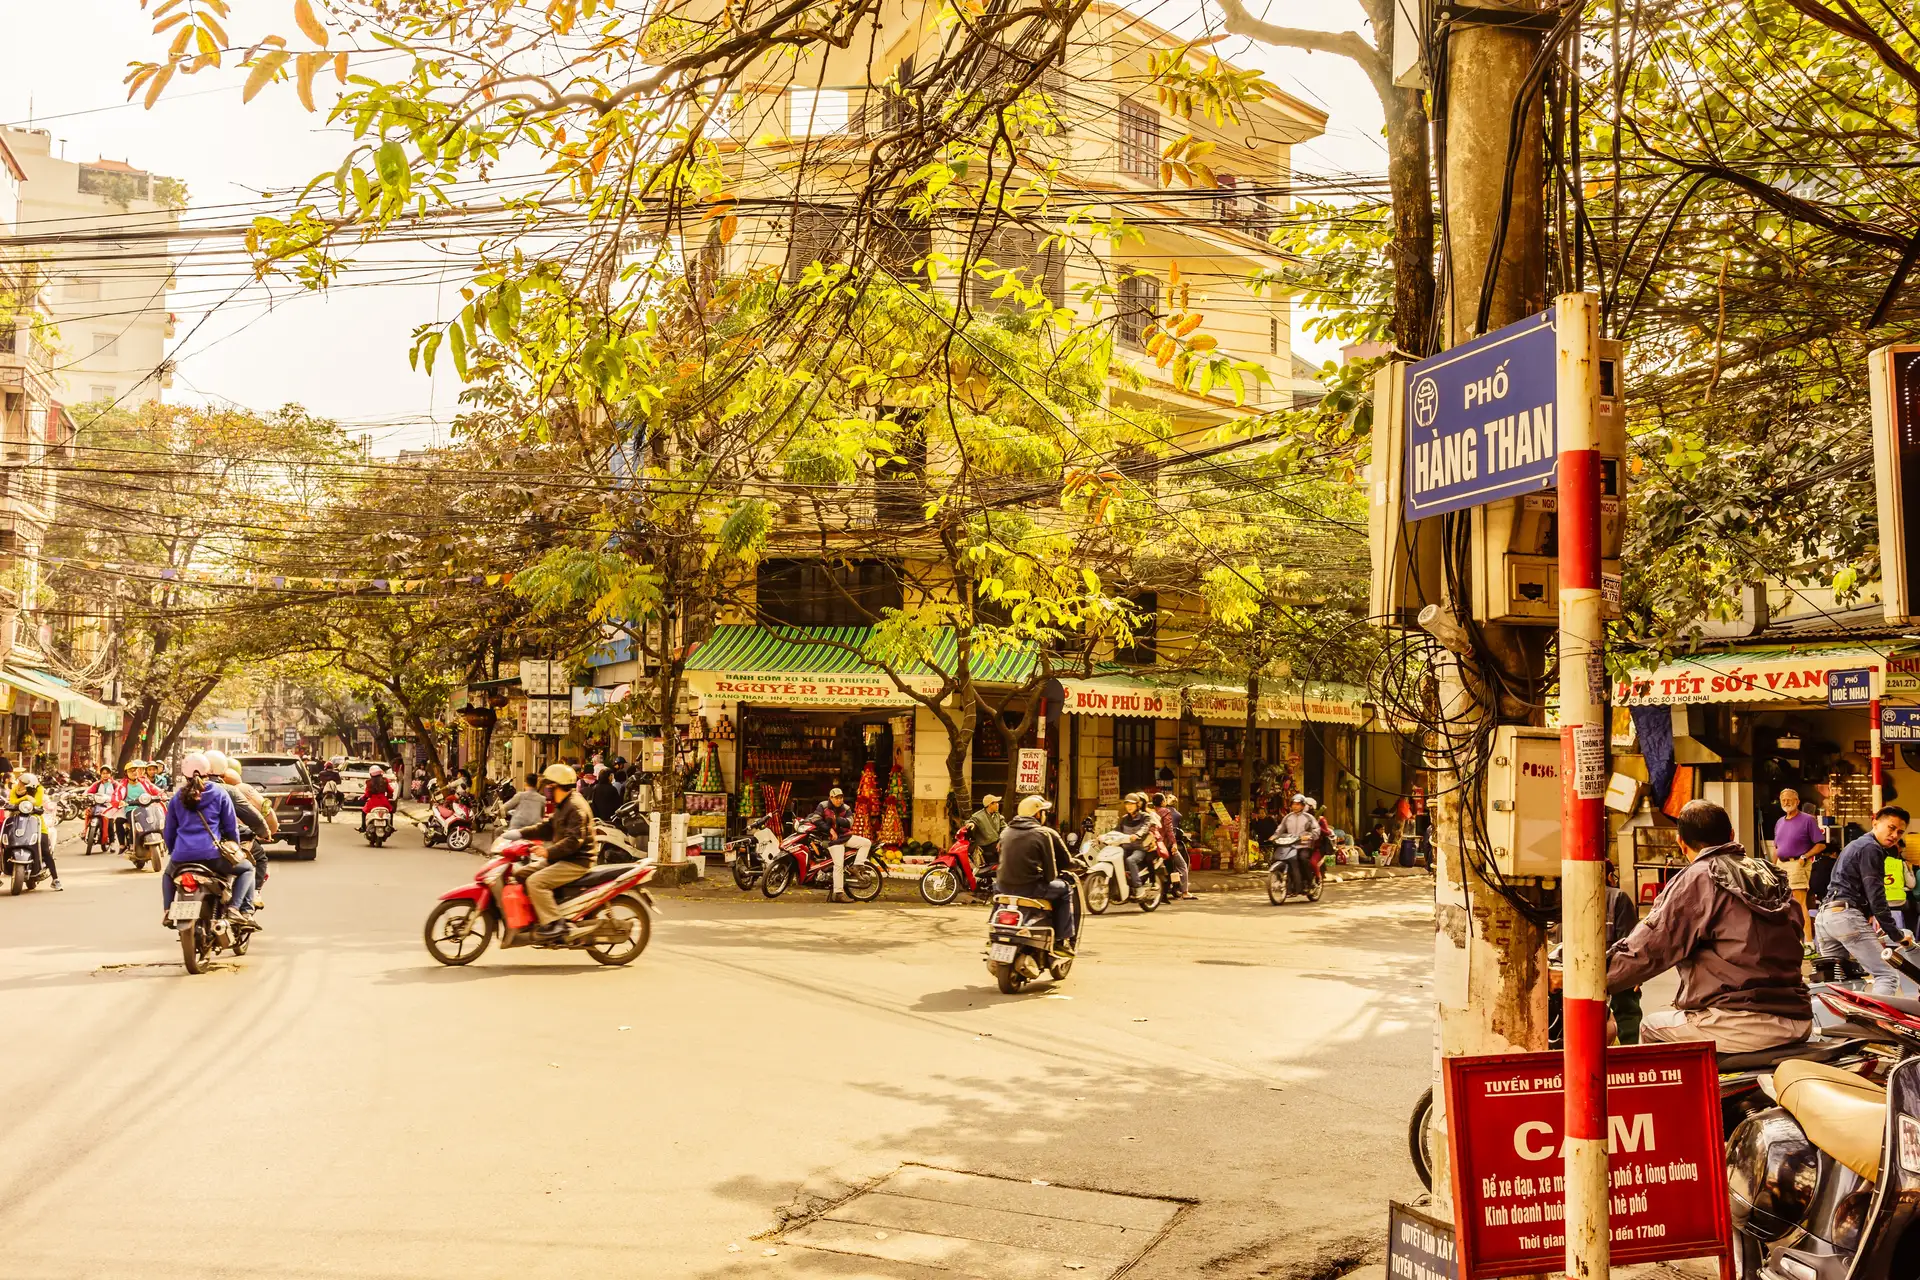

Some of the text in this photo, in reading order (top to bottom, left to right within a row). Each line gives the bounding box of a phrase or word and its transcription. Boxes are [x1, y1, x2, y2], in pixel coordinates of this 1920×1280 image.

[1464, 359, 1510, 409] PHỐ
[1414, 403, 1553, 494] HÀNG THAN
[1661, 671, 1704, 695] TẾT
[1711, 667, 1758, 693] SỐT
[1845, 675, 1859, 684] PHỐ
[1077, 689, 1108, 708] BÚN
[1111, 692, 1141, 711] PHÚ
[1832, 685, 1869, 701] HOÈ NHAI
[1022, 760, 1039, 770] SIM
[1485, 1075, 1529, 1093] TUYẾN
[1534, 1073, 1562, 1090] PHỐ
[1638, 1069, 1657, 1083] ĐÔ
[1660, 1068, 1682, 1083] THỊ
[1513, 1113, 1656, 1161] CM
[1482, 1173, 1497, 1199] Để
[1499, 1179, 1512, 1197] xe
[1514, 1175, 1536, 1200] đạp,
[1538, 1176, 1551, 1194] xe
[1614, 1162, 1632, 1189] phố
[1635, 1165, 1643, 1184] &
[1645, 1163, 1666, 1184] lòng
[1668, 1157, 1698, 1182] đường
[1485, 1205, 1509, 1226] Kinh
[1511, 1202, 1542, 1225] doanh
[1614, 1193, 1627, 1215] hè
[1629, 1188, 1648, 1216] phố
[1437, 1235, 1454, 1261] XÂY
[1518, 1233, 1540, 1250] Thời
[1543, 1233, 1565, 1250] gian
[1615, 1225, 1633, 1241] đến
[1636, 1223, 1666, 1239] 17h00
[1392, 1253, 1413, 1279] TUYẾN
